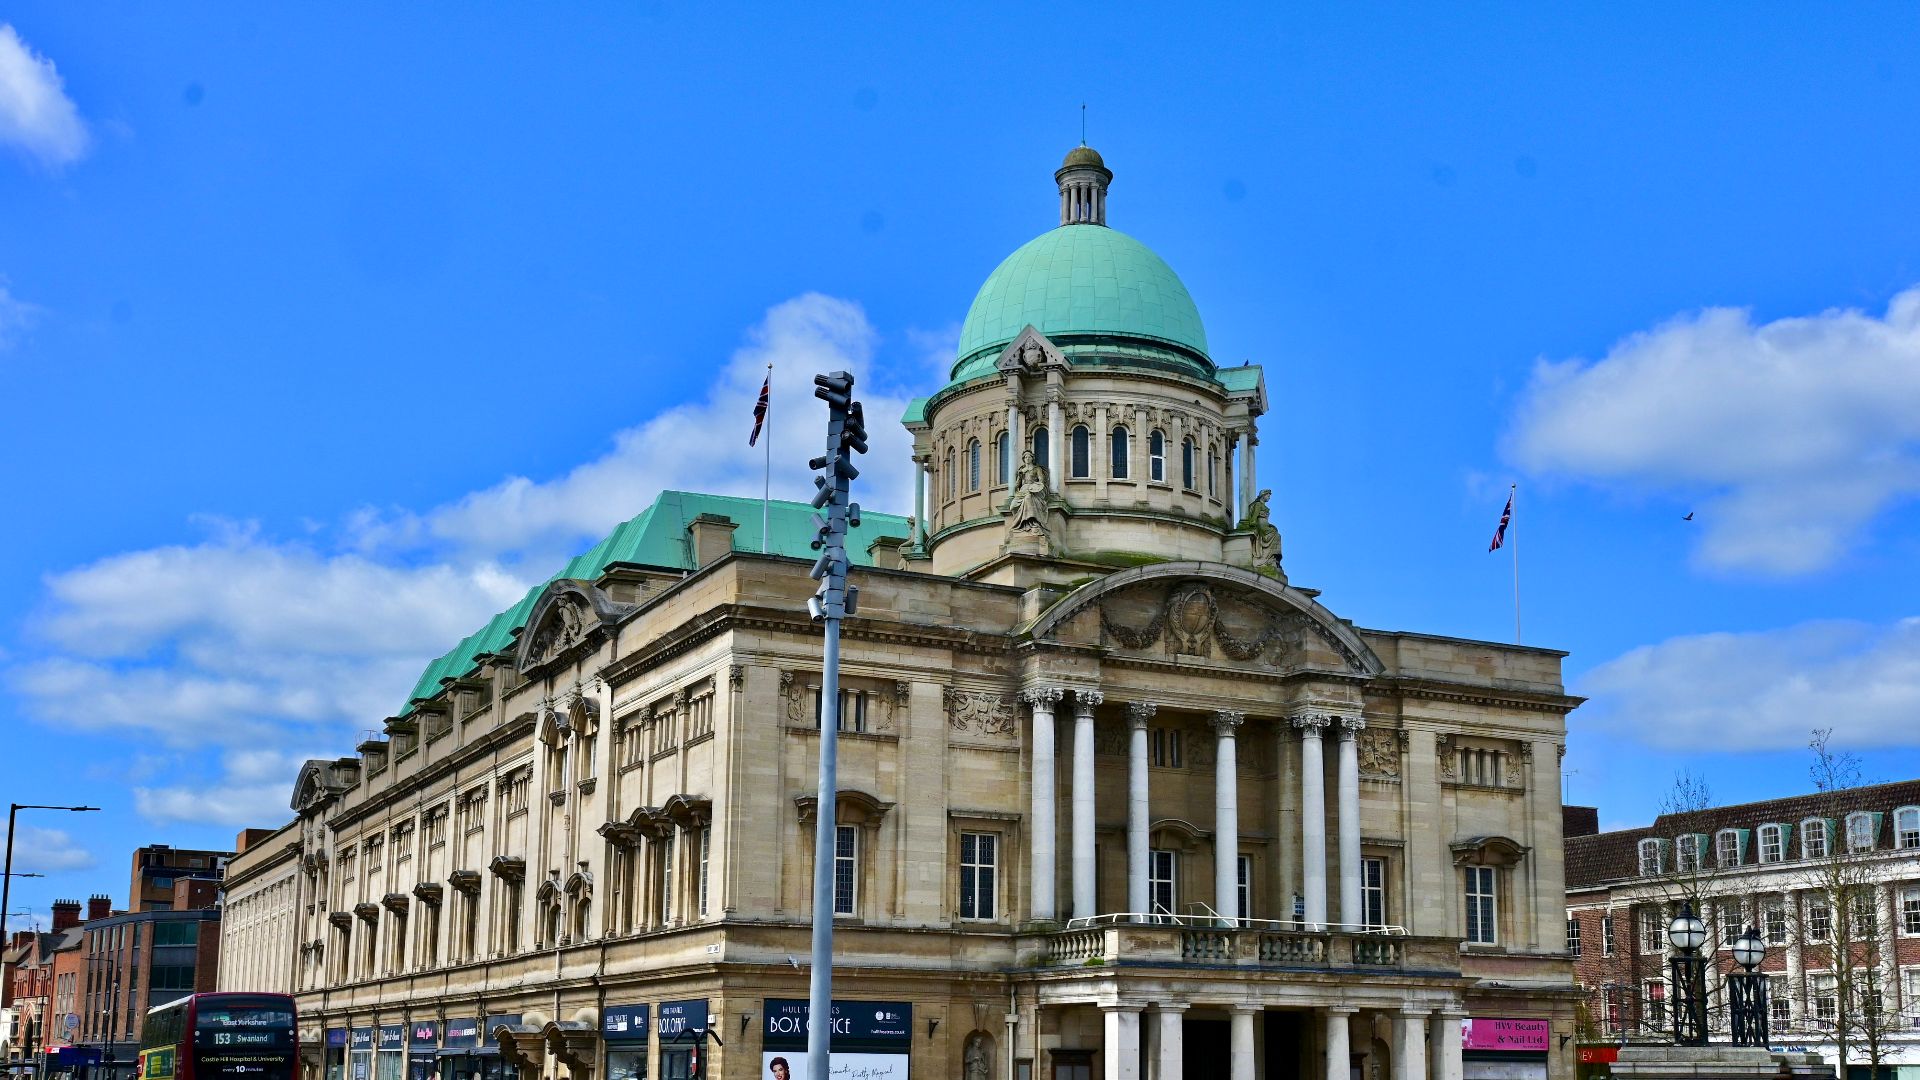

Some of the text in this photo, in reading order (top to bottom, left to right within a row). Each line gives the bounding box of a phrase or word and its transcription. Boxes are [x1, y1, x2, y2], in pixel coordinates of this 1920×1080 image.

[782, 1006, 801, 1014] HULL
[770, 1016, 801, 1033] BOX
[1515, 1022, 1545, 1033] Beauty
[214, 1033, 268, 1045] 153 Swanland
[1497, 1035, 1545, 1044] & Nail Ltd.
[235, 1065, 246, 1073] 10
